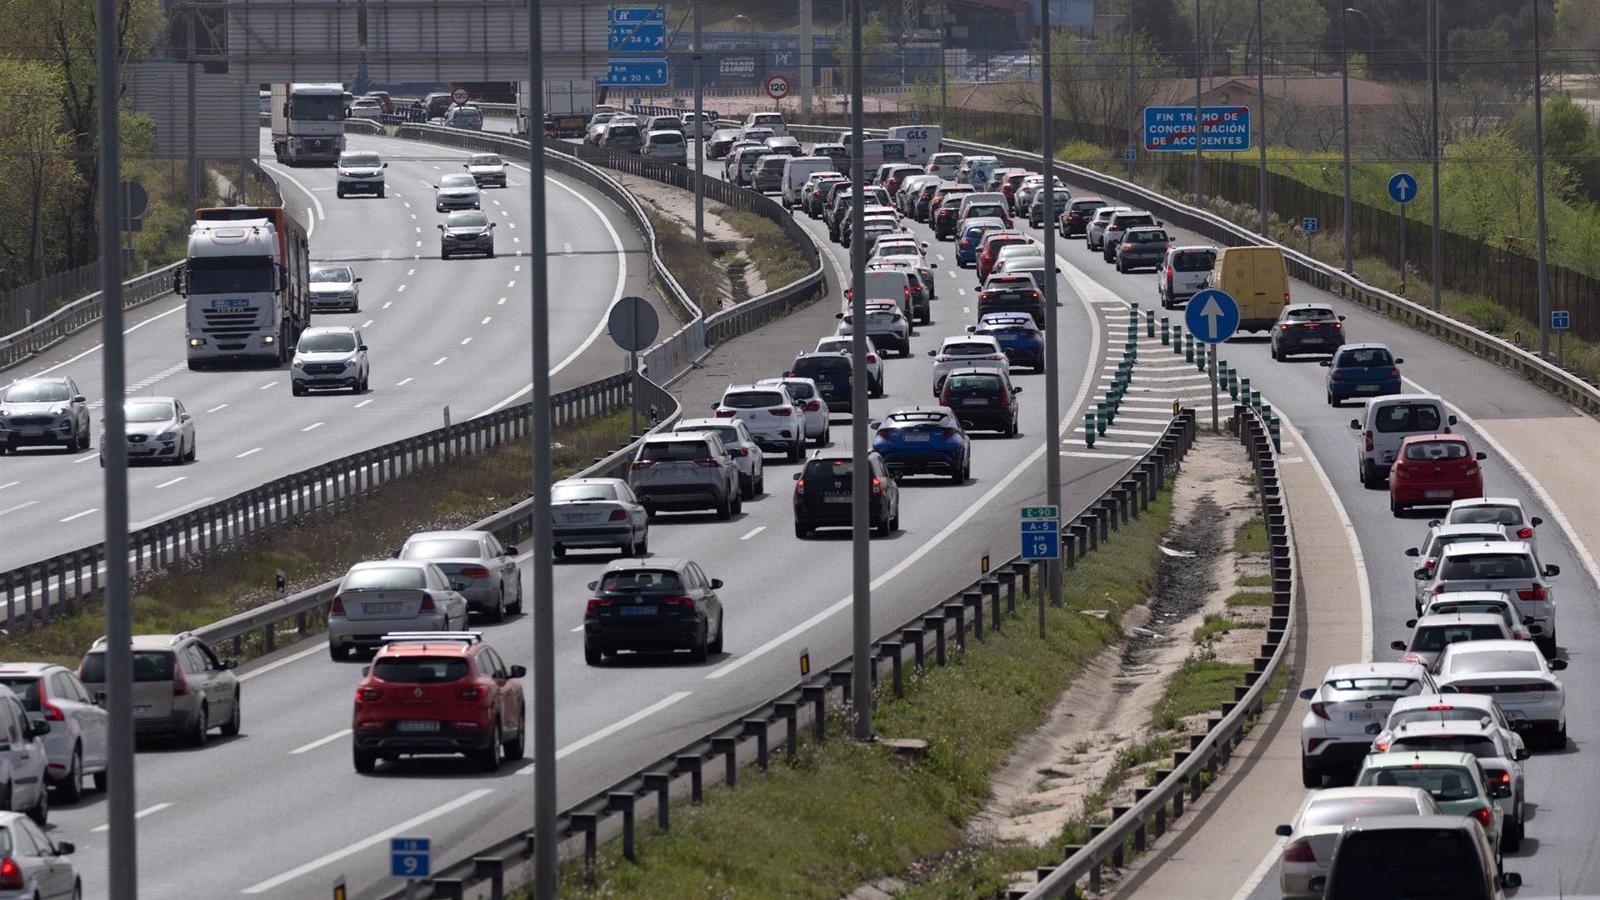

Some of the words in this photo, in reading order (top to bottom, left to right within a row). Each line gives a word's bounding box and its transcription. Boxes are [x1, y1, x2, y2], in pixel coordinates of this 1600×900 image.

[770, 83, 786, 92] 120
[1156, 113, 1174, 122] FIN
[1224, 113, 1238, 121] DE
[1149, 122, 1246, 134] CONCENRACIÓN
[907, 131, 928, 140] GLS
[1152, 137, 1167, 145] DE
[1173, 137, 1242, 145] ACCDENTES
[1027, 509, 1052, 517] E-90
[1030, 522, 1049, 530] A-5
[1032, 543, 1048, 555] 19
[403, 856, 418, 873] 9
